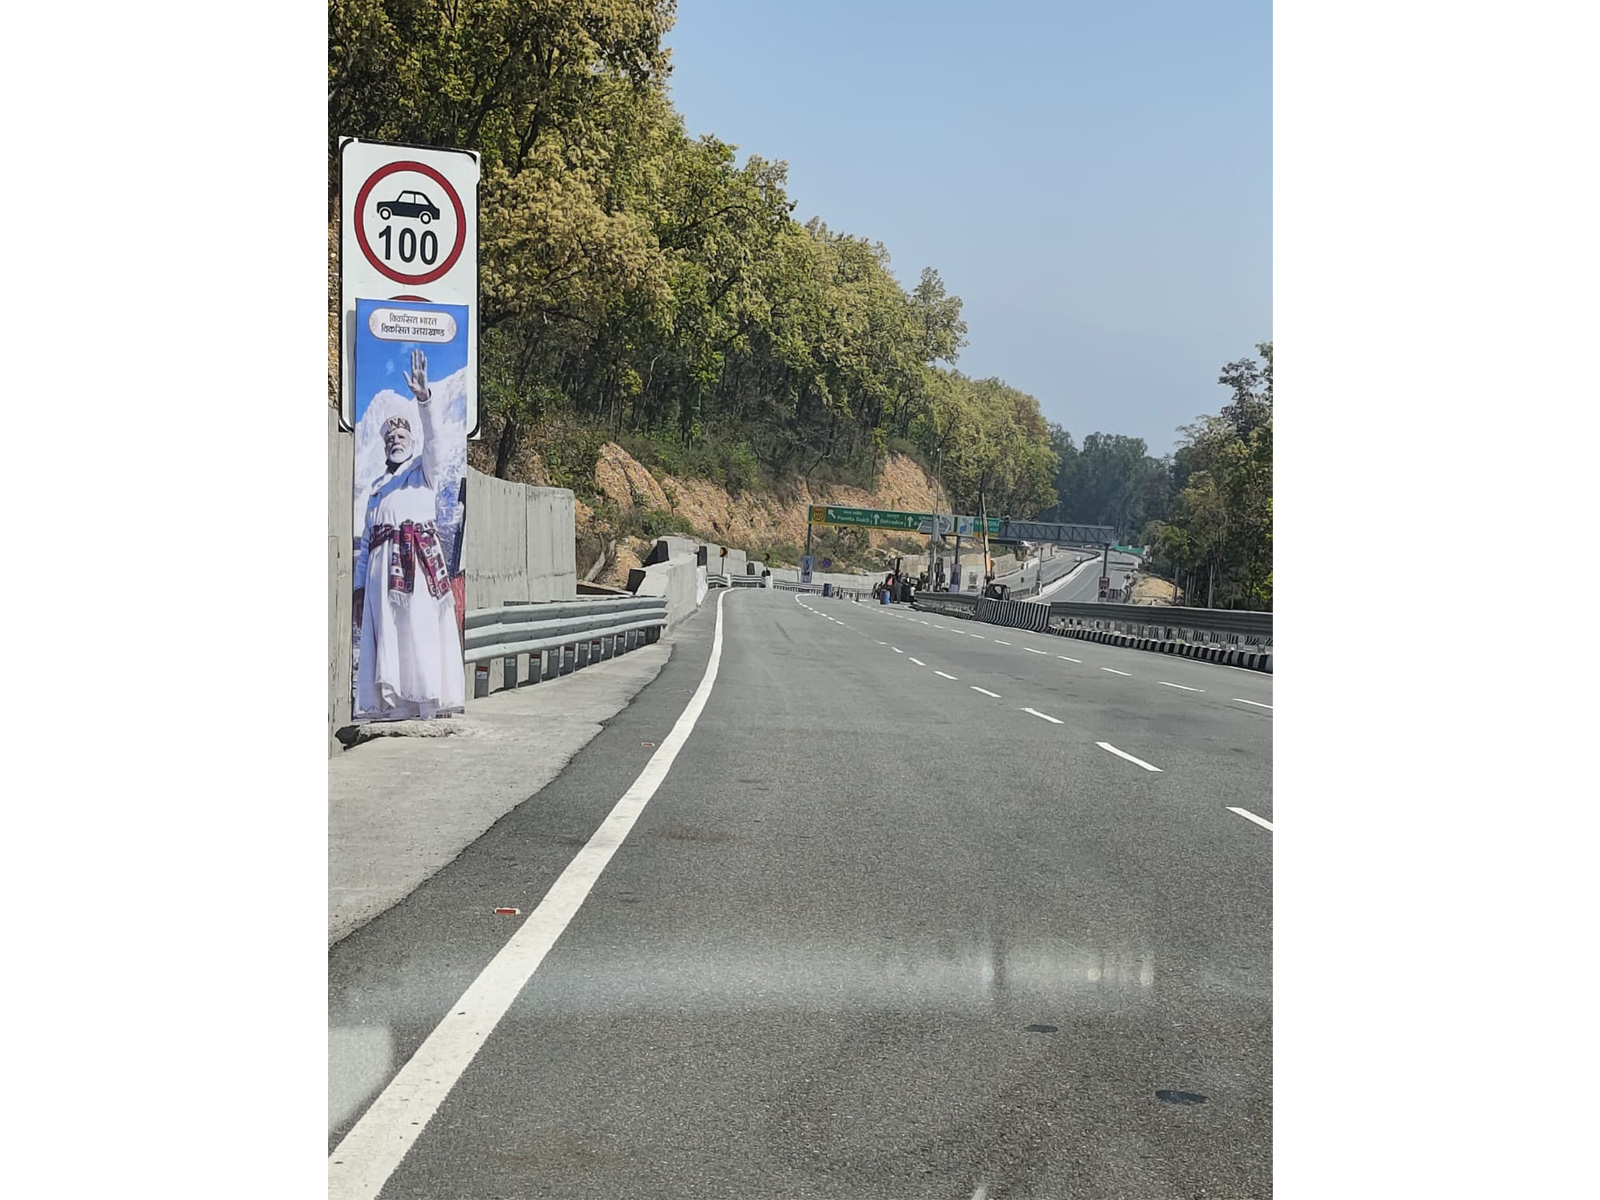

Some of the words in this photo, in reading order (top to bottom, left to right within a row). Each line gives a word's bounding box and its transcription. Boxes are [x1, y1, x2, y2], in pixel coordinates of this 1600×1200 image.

[379, 225, 438, 265] 100
[389, 313, 418, 324] विकसित
[419, 316, 437, 326] भारत
[381, 323, 410, 335] विकसित
[411, 326, 445, 337] उत्तराखण्ड
